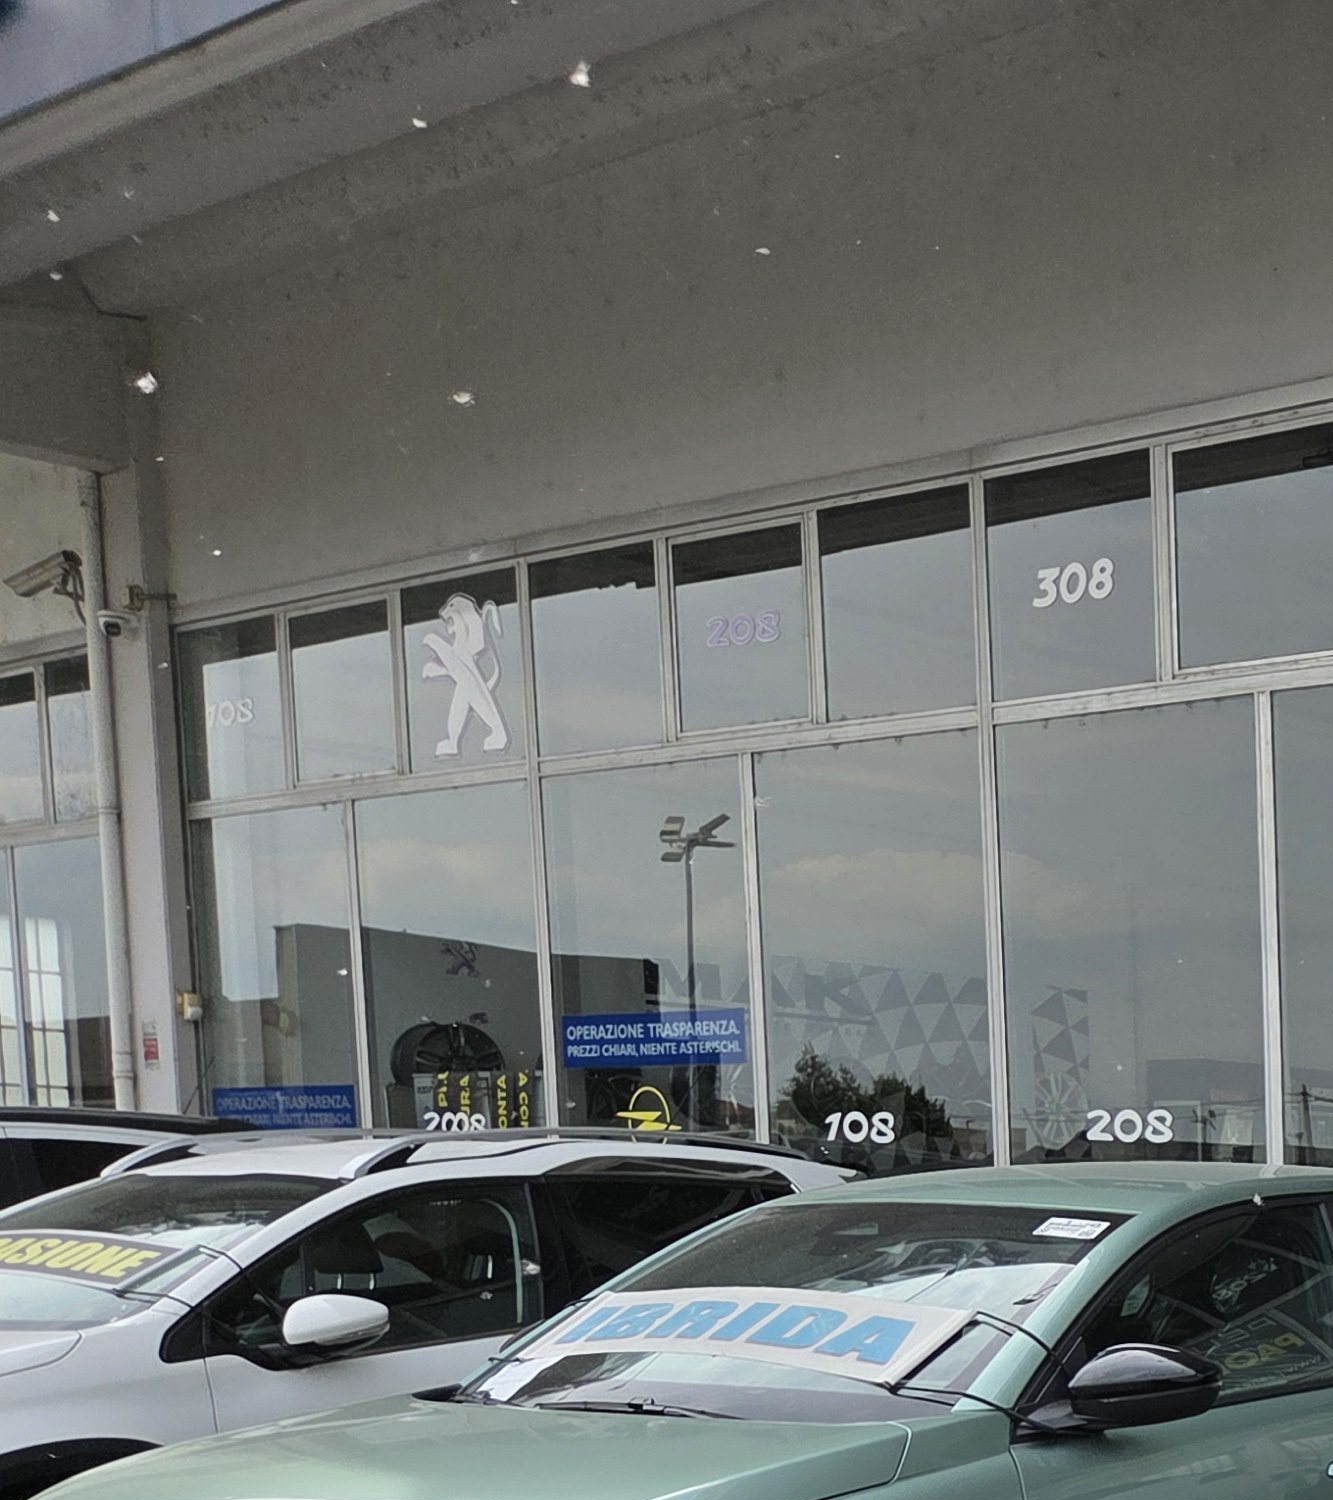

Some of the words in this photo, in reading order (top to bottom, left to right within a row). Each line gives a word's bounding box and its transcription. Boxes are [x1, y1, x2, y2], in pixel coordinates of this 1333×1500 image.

[1033, 557, 1114, 609] 308
[705, 610, 781, 648] 208
[567, 1024, 644, 1040] OPERAZIONE
[648, 1020, 740, 1038] TRASPARENZA.
[567, 1045, 601, 1057] PREZZI
[640, 1043, 677, 1055] NIENTE
[423, 1111, 486, 1131] 2008
[825, 1111, 895, 1144] 108
[1086, 1109, 1174, 1143] 208
[556, 1300, 918, 1366] IBRIDA
